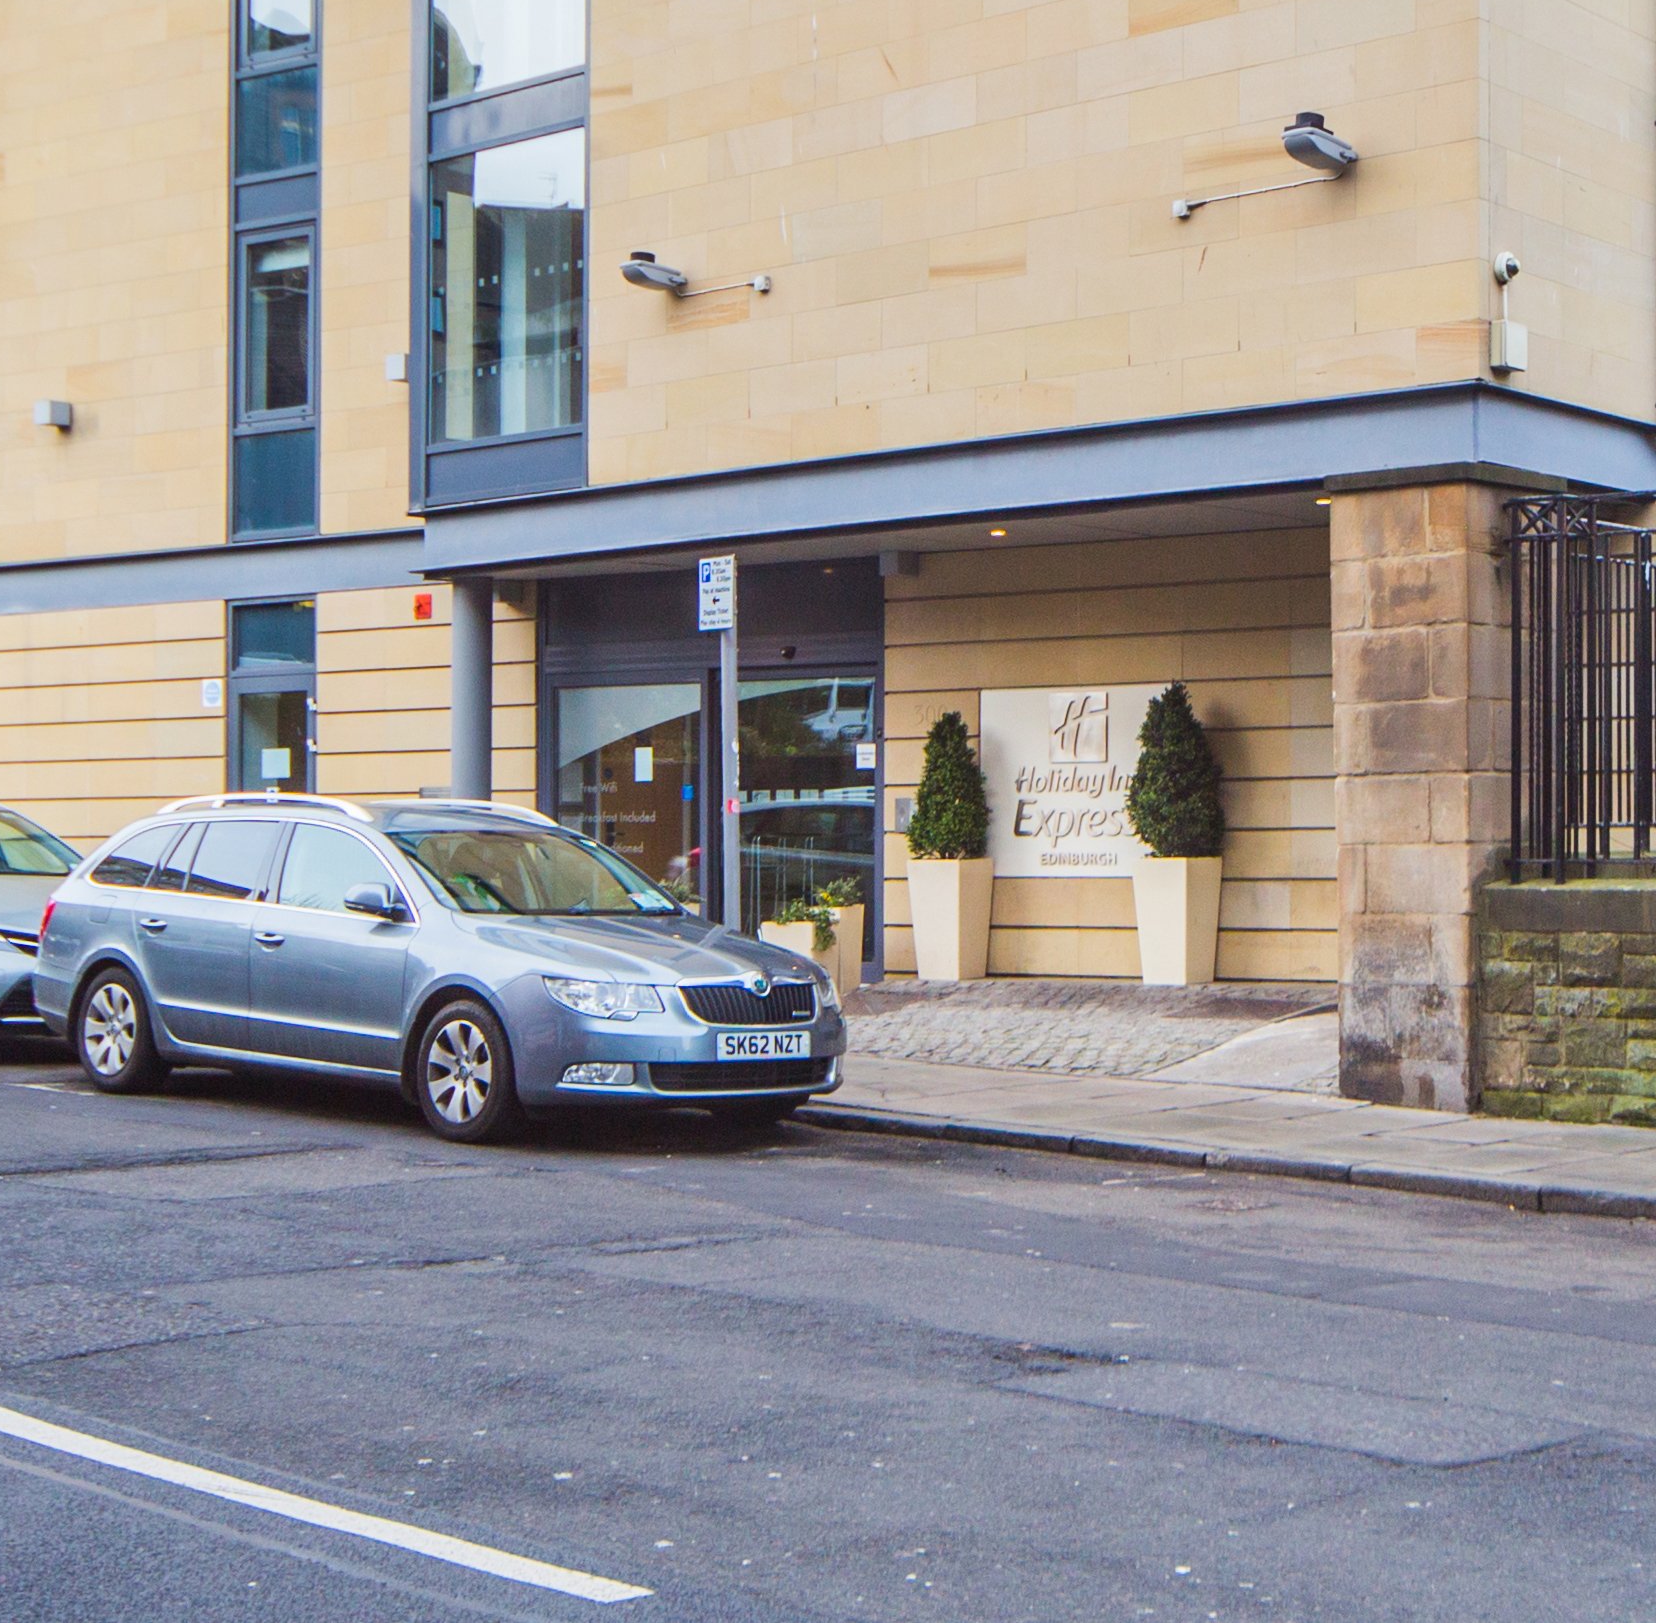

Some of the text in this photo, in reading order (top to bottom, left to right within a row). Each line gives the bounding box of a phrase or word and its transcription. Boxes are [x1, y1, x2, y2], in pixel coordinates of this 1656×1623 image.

[1015, 764, 1105, 799] Holiday
[619, 809, 657, 823] Included
[1040, 851, 1118, 866] EDINBURGH
[725, 1034, 803, 1055] SK62 NZT
